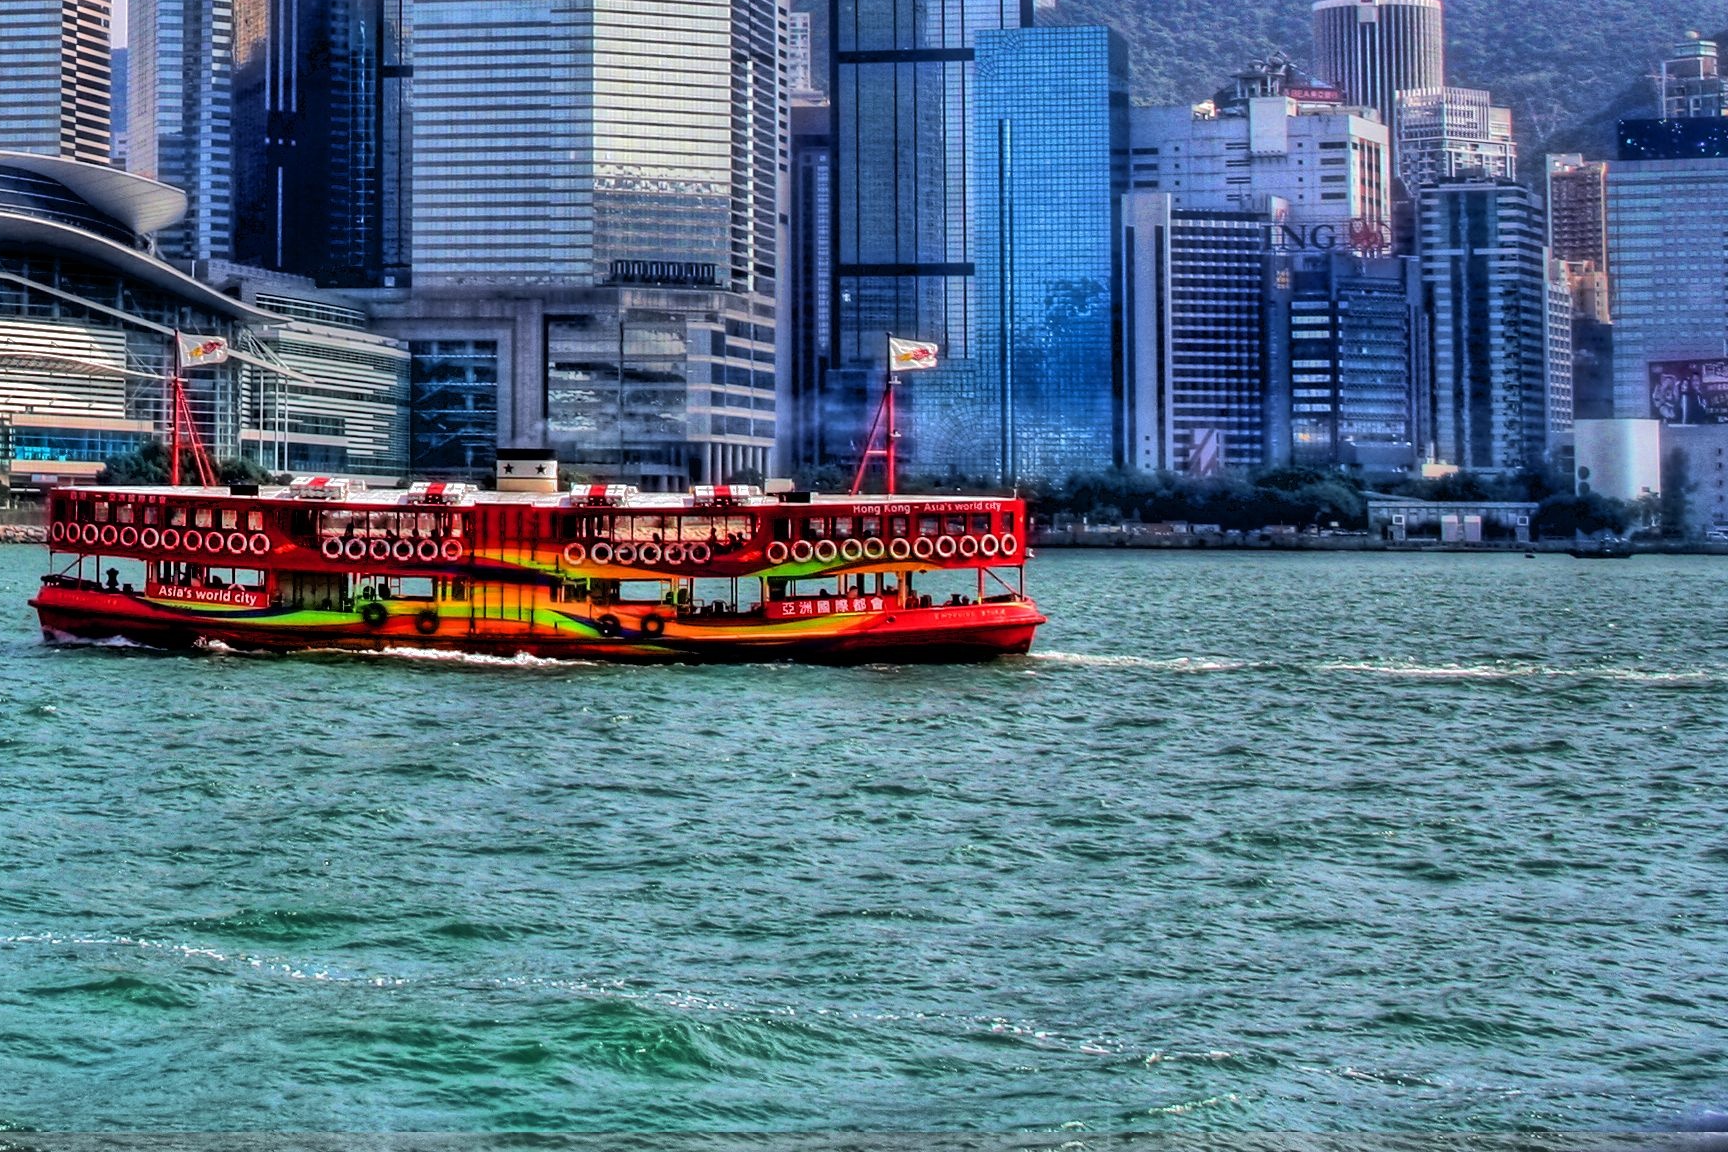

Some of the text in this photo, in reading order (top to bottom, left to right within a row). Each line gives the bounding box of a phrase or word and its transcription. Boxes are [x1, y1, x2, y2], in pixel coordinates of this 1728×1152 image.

[1261, 224, 1336, 250] ING
[852, 504, 881, 515] Hong
[884, 503, 911, 514] Kong
[955, 501, 983, 511] world
[985, 501, 1002, 512] city
[158, 585, 257, 606] Asia's world city
